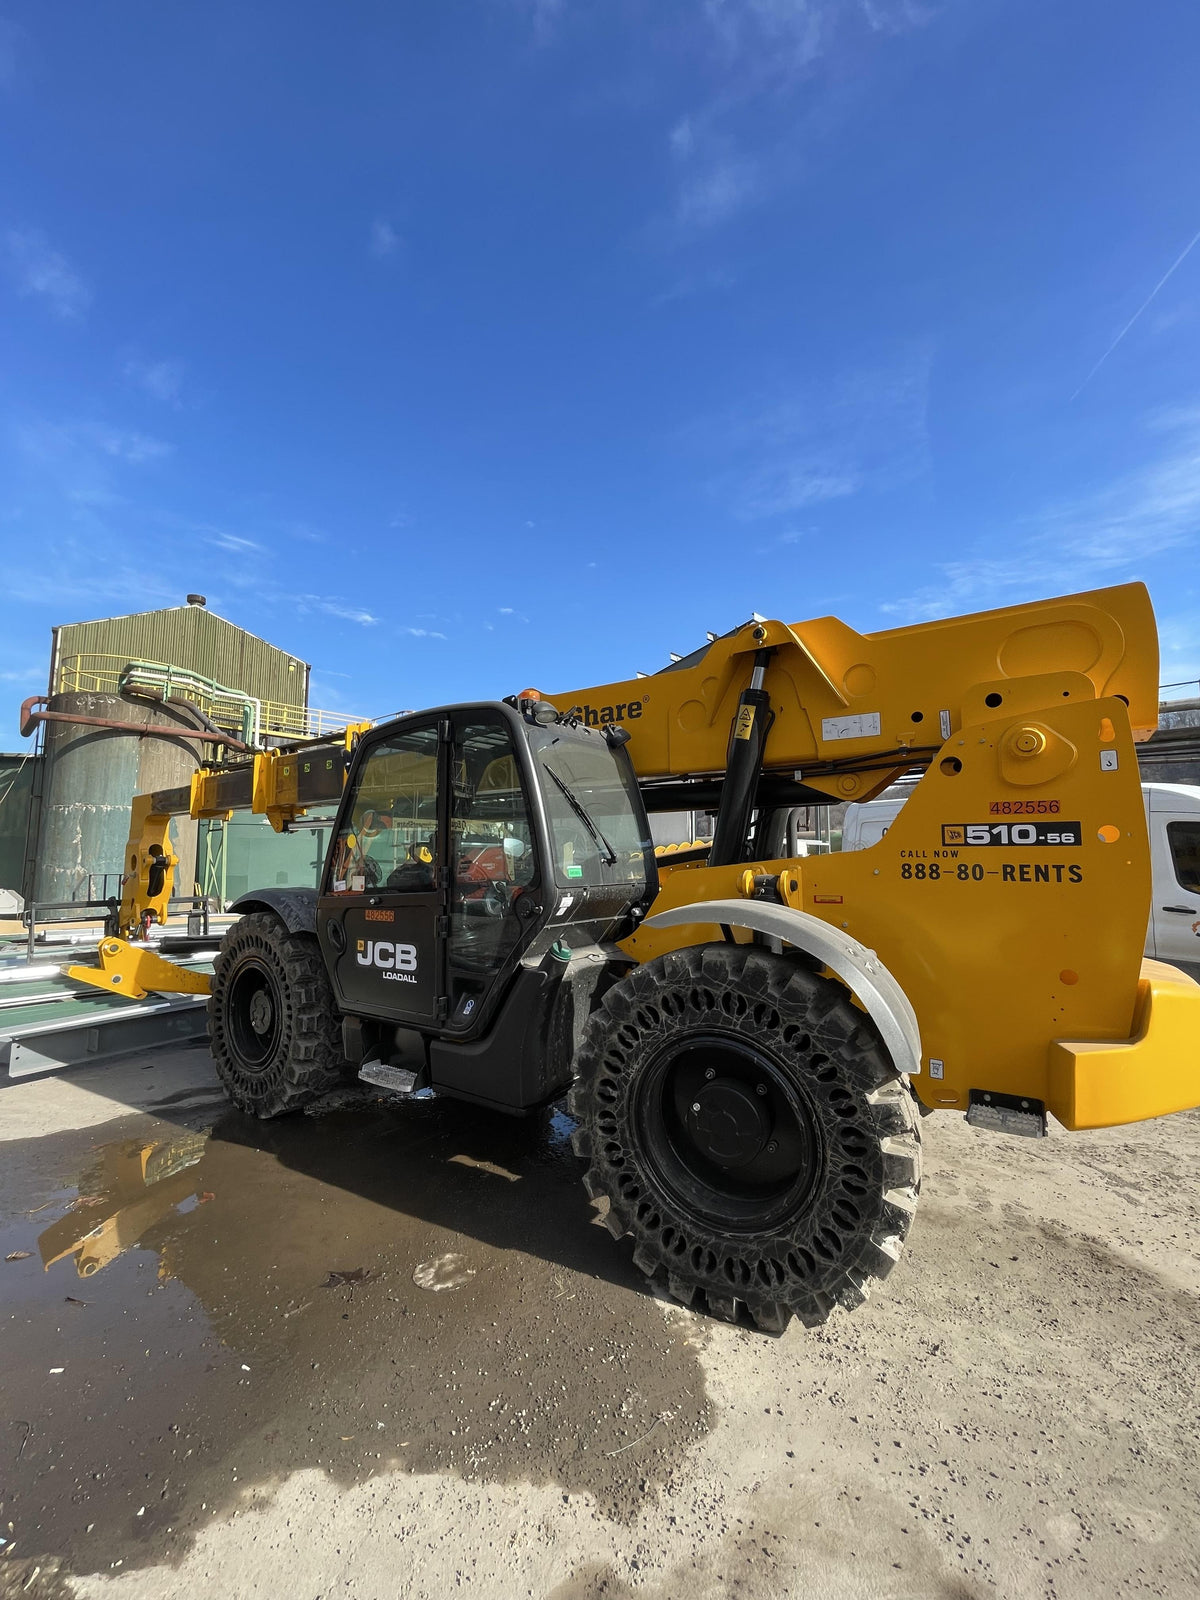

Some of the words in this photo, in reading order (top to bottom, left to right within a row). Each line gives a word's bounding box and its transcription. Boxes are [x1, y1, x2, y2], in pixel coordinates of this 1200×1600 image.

[990, 800, 1060, 815] 482556
[966, 824, 1075, 844] 510-56
[900, 850, 928, 858] CALL
[933, 850, 959, 858] NOW
[901, 863, 1083, 883] 888-80-RENTS
[357, 940, 417, 971] JCB
[382, 971, 418, 983] LOADALL
